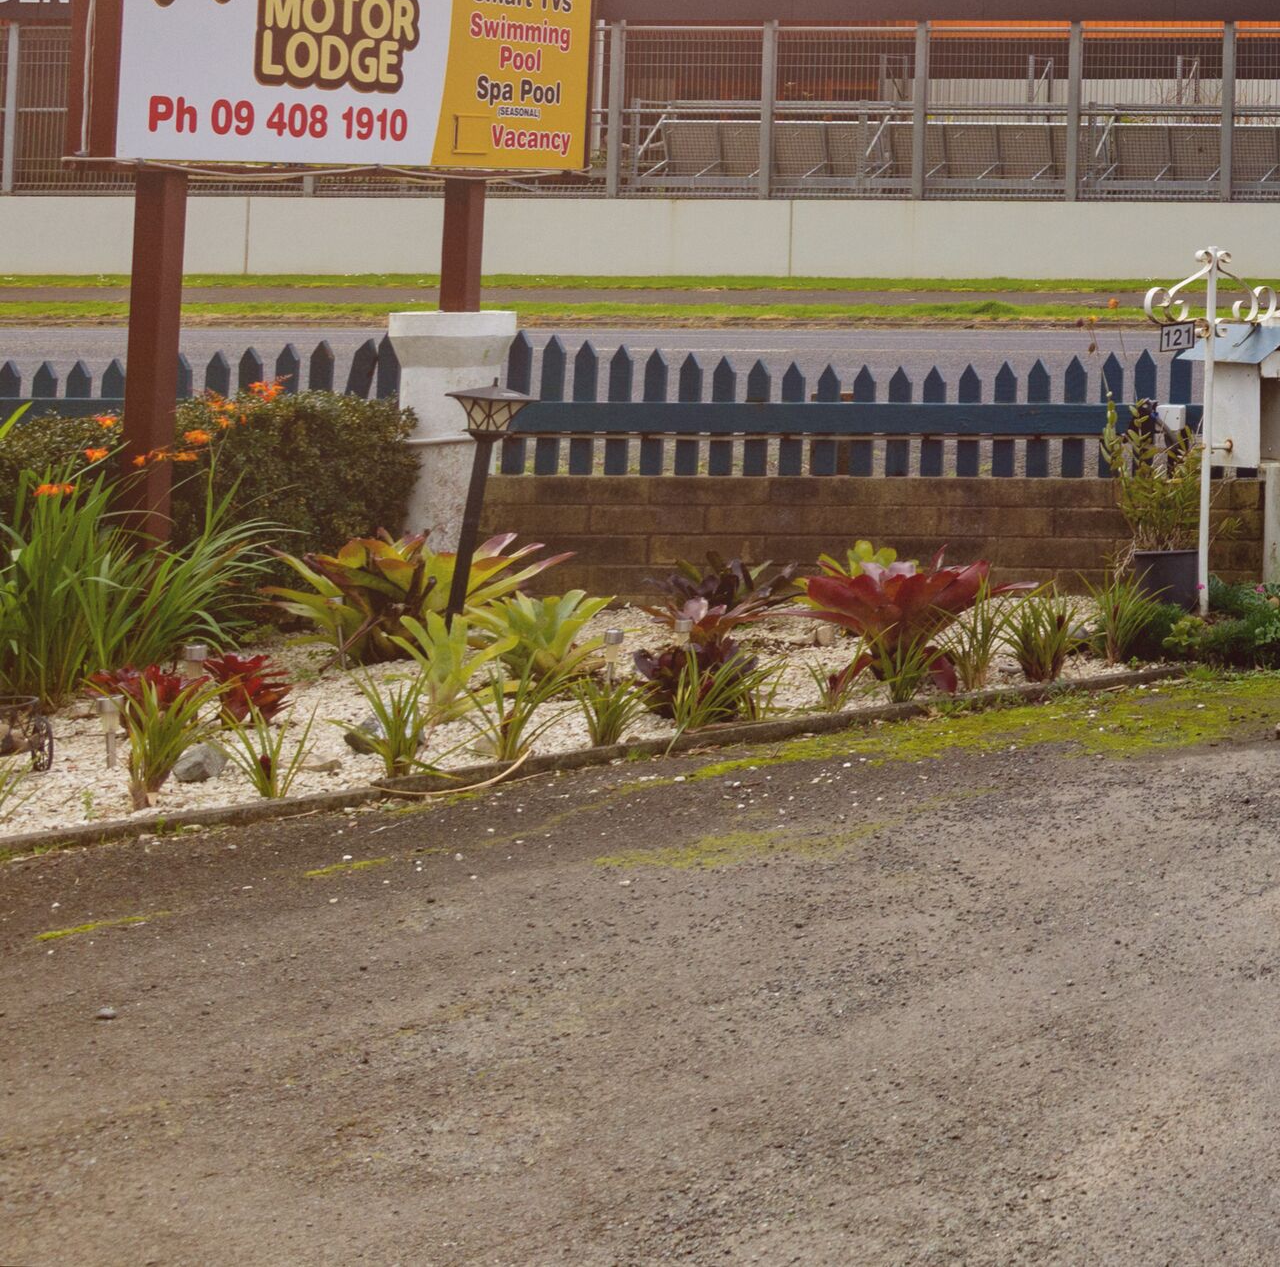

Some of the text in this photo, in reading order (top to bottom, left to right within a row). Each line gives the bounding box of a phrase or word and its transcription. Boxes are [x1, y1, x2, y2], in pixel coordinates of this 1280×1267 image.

[470, 12, 572, 52] Swimming
[261, 29, 400, 84] LODGE
[499, 45, 542, 72] Pool
[476, 75, 562, 106] Spa Pool
[148, 95, 408, 142] Ph 09 408 1910
[491, 123, 572, 156] Vacancy
[1164, 327, 1192, 347] 121
